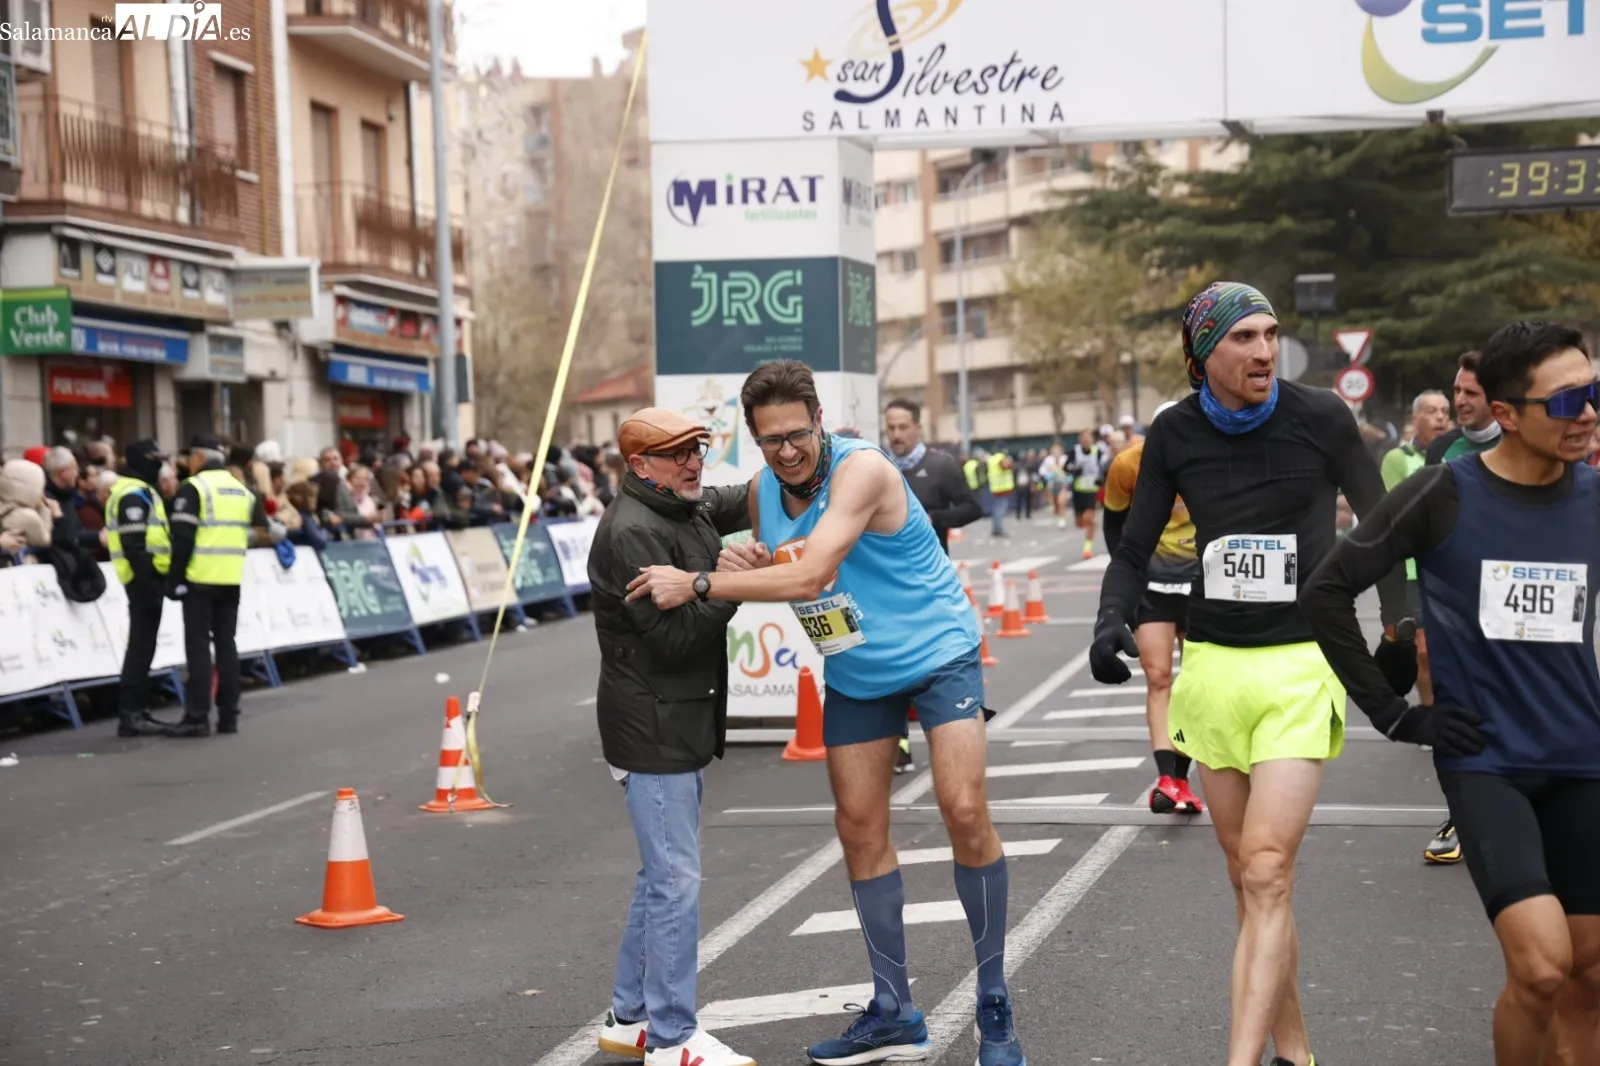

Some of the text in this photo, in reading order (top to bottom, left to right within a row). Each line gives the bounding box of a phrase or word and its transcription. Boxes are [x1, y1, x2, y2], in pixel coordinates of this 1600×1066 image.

[802, 101, 1066, 132] SALMANTINA
[690, 264, 803, 326] JRG
[14, 304, 59, 328] Club
[9, 325, 66, 348] Verde
[1227, 539, 1287, 550] SETEL
[1223, 552, 1265, 579] 540
[1511, 566, 1579, 582] SETEL
[798, 600, 840, 616] SETEL
[1503, 583, 1555, 614] 496
